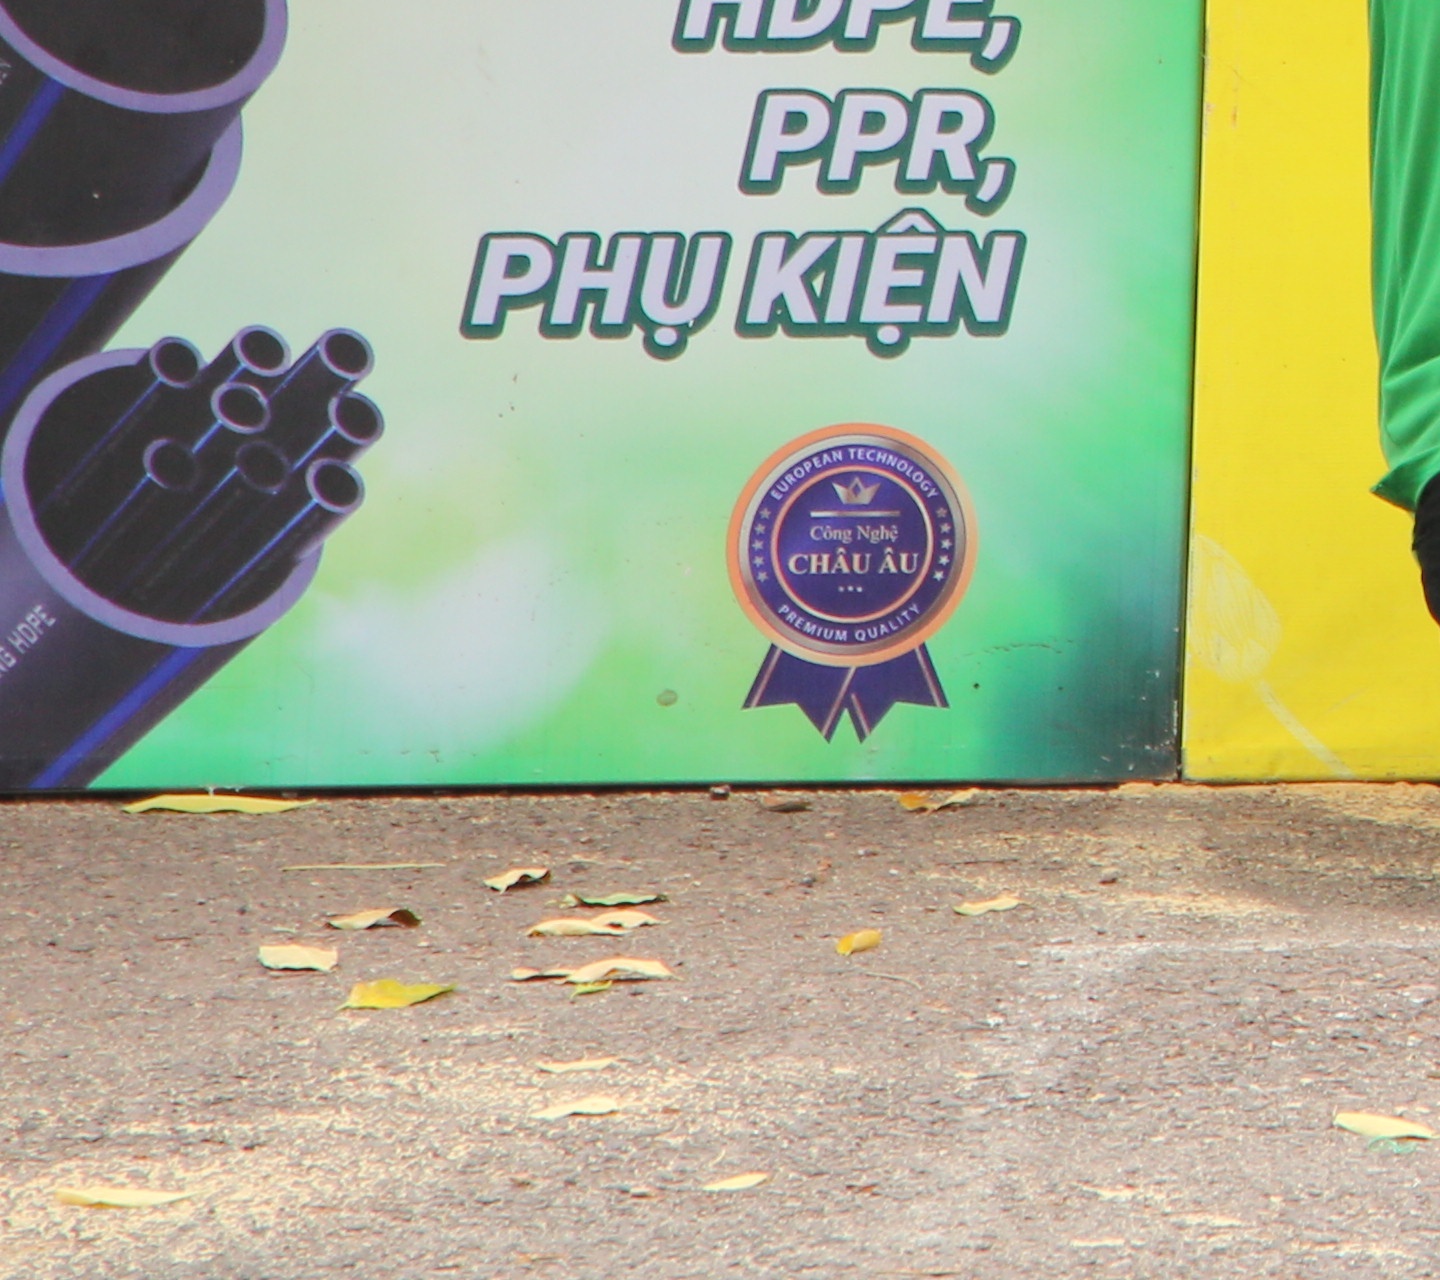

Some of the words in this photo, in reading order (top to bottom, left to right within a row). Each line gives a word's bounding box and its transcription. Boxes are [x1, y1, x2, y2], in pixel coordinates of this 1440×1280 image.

[738, 88, 1015, 217] PPR,
[459, 232, 732, 360] PHỤ
[735, 208, 1027, 358] KIỆN
[770, 449, 843, 501] EUROPEAN
[848, 447, 939, 500] TECHNOLOGY
[810, 525, 852, 543] Công
[857, 525, 899, 543] Nghệ
[788, 547, 872, 575] CHÂU
[878, 547, 919, 575] ÂU
[777, 604, 848, 642] PREMIUM
[854, 603, 921, 643] QUALITY
